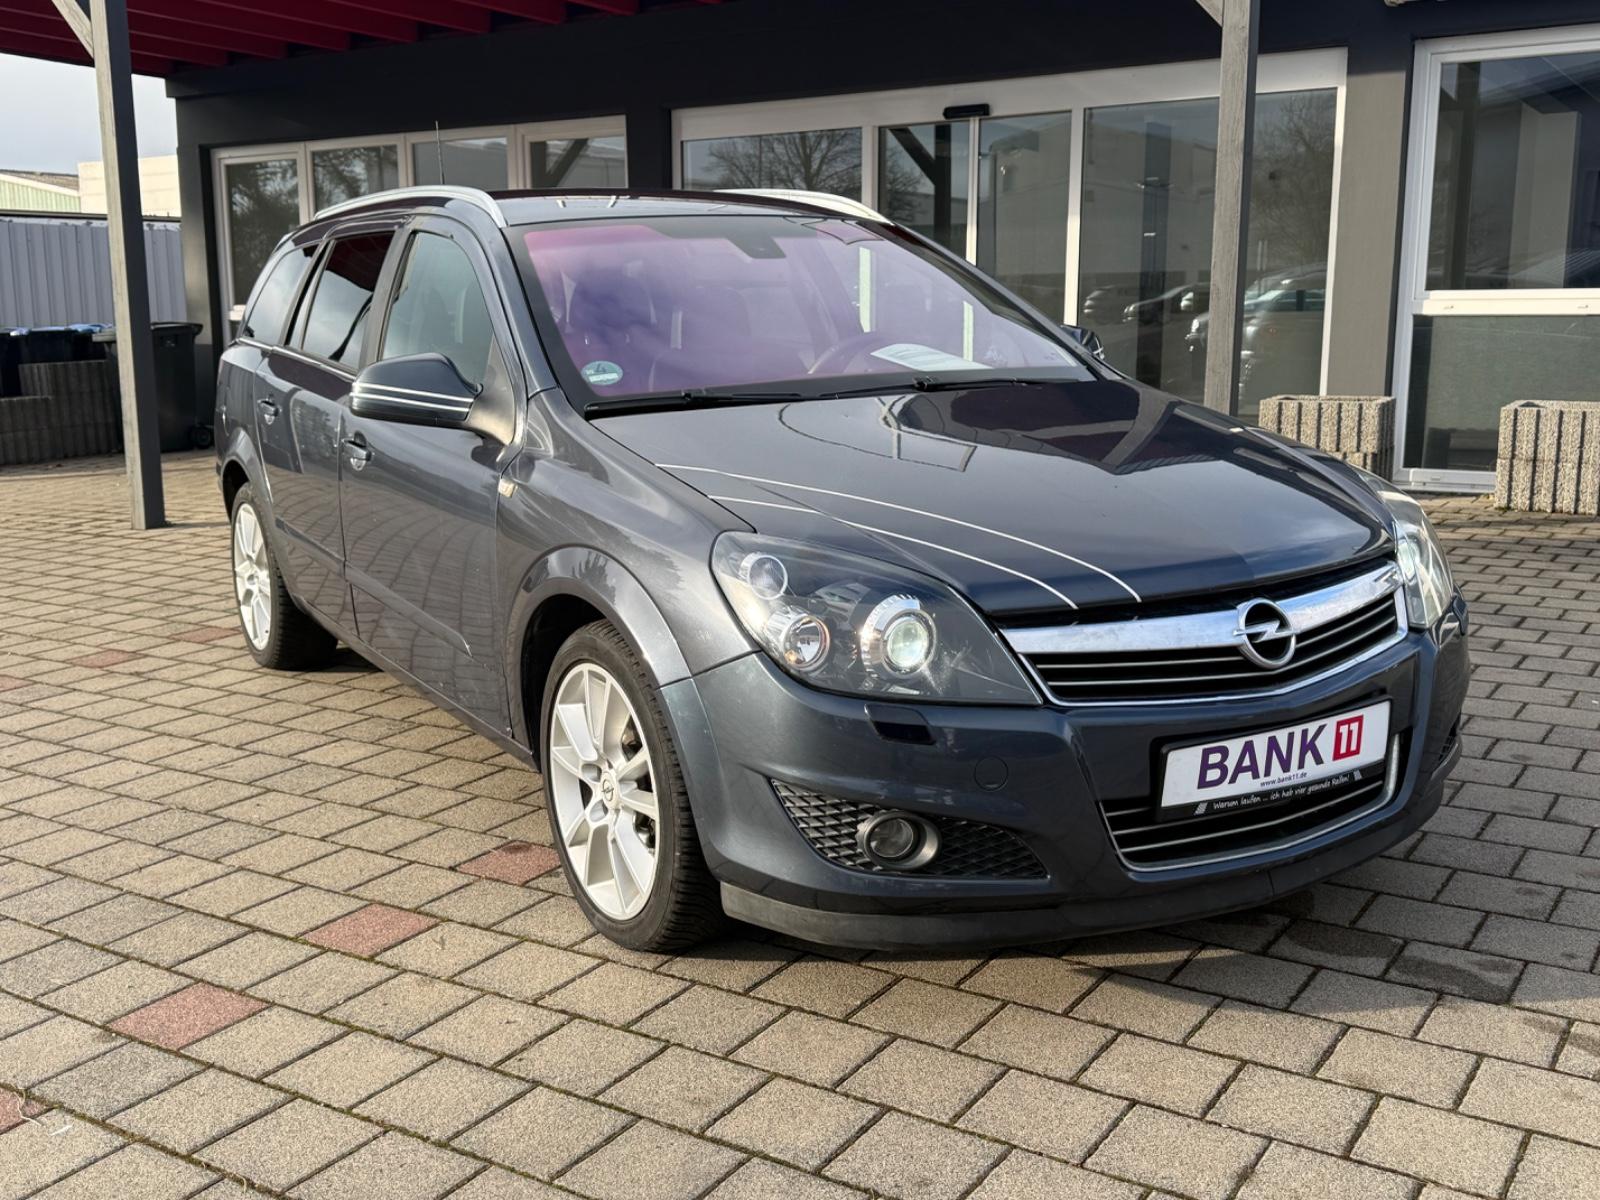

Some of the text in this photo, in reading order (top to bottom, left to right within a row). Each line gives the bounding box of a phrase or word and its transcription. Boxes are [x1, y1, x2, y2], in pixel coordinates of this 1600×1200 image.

[1197, 722, 1359, 789] BANK 11
[1260, 772, 1307, 787] www.bank11.de
[1213, 800, 1239, 810] Warum
[1240, 795, 1261, 806] laufen
[1270, 791, 1280, 800] ich
[1281, 788, 1294, 798] hab
[1295, 785, 1307, 795] vier
